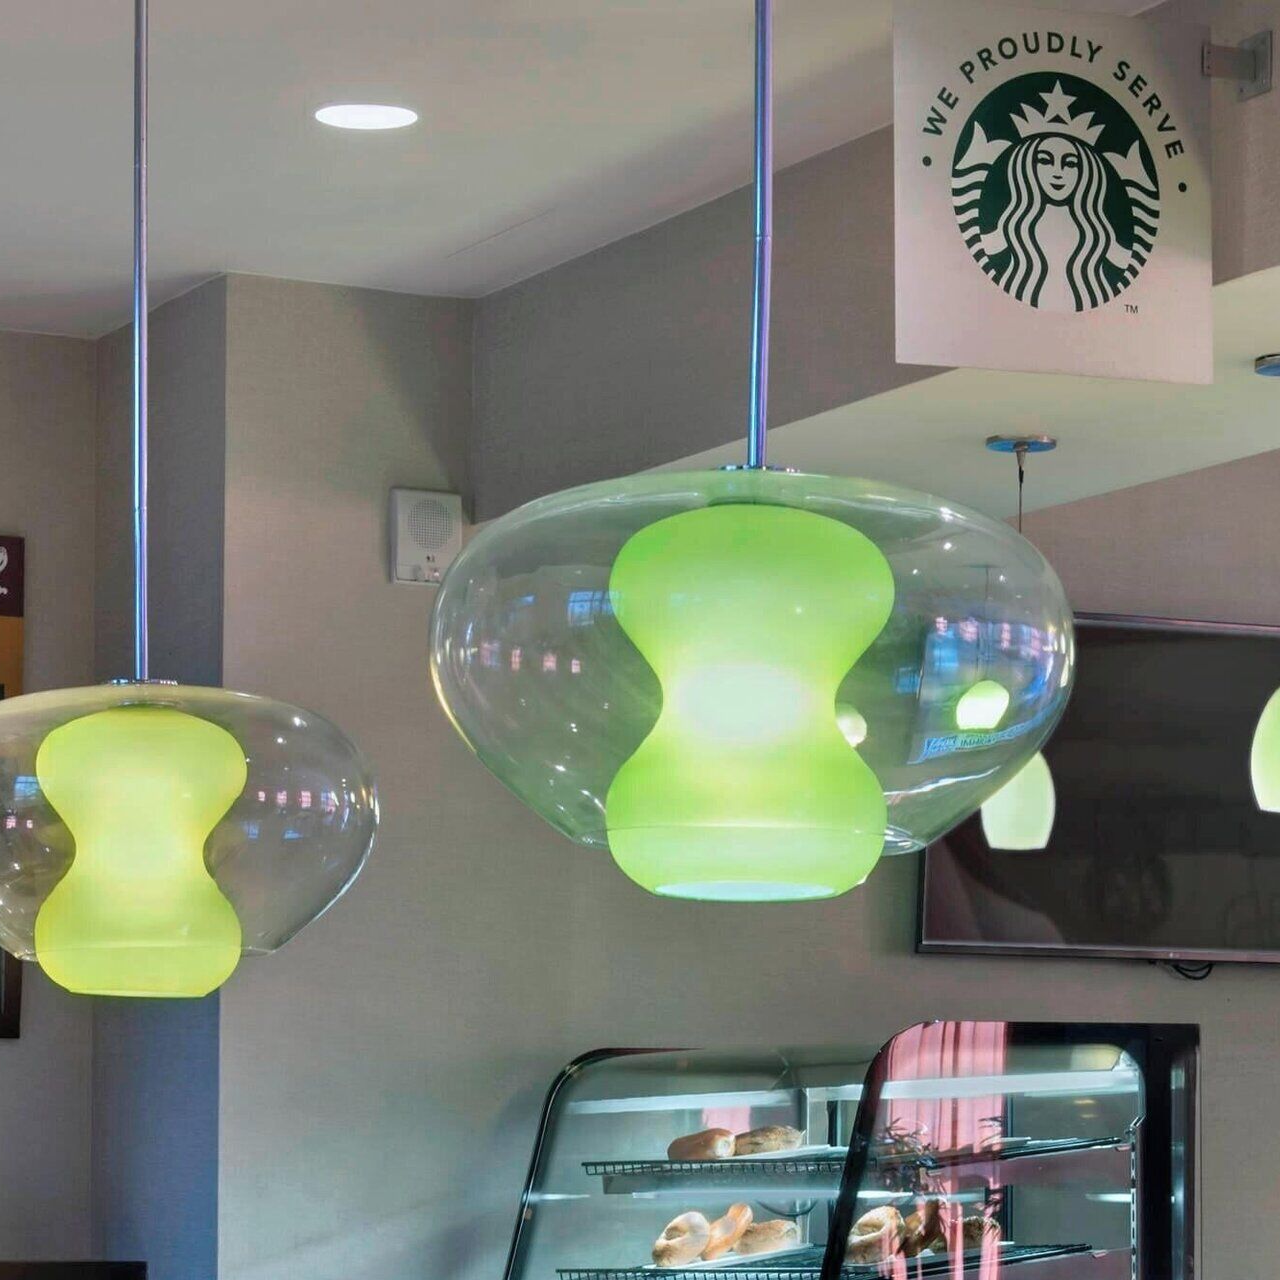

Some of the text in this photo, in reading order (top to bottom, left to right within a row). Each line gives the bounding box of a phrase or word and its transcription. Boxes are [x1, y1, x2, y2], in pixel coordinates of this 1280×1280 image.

[923, 31, 1185, 159] WE PROUDLY SERVE
